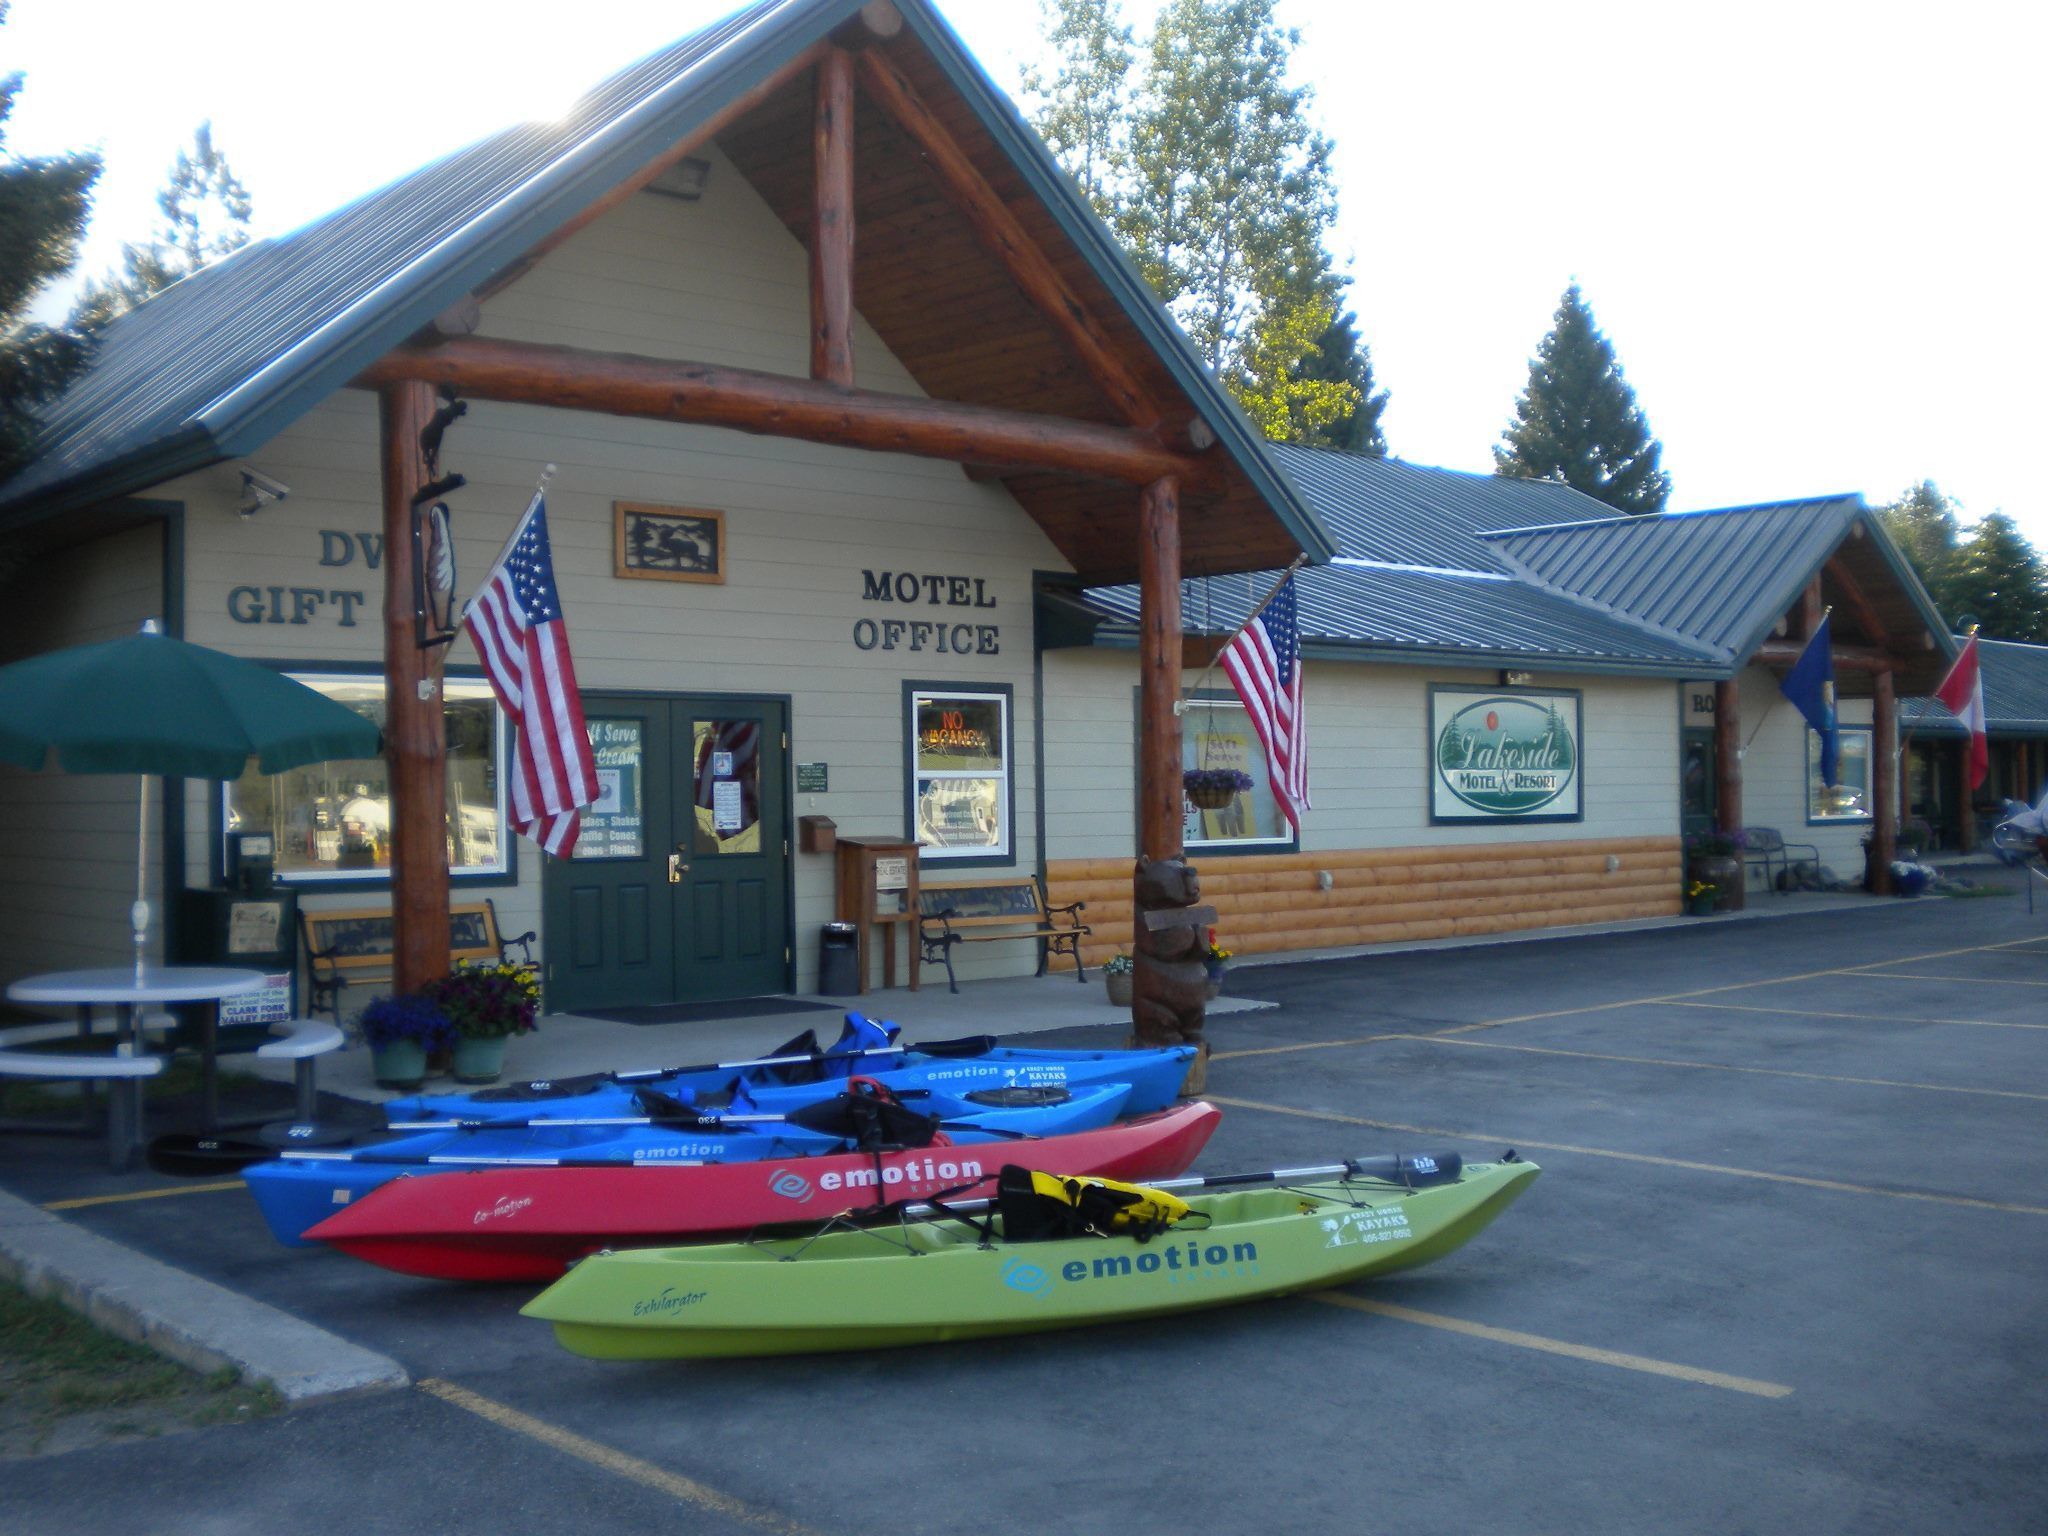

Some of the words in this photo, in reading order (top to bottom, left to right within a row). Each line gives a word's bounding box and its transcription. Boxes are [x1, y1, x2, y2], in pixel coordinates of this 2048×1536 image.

[862, 569, 996, 608] MOTEL
[228, 586, 364, 627] GIFT
[854, 618, 999, 655] OFFICE
[943, 711, 963, 729] NO
[604, 723, 638, 742] Serve
[597, 747, 639, 766] Cream
[1460, 728, 1559, 770] Lakeside
[1460, 773, 1498, 790] MOTEL
[1515, 773, 1556, 788] RESORT
[611, 816, 640, 826] Shakes
[609, 830, 636, 841] Cones
[222, 1014, 257, 1024] VALLEY
[260, 1012, 289, 1022] PRESS
[227, 1005, 258, 1015] CLARK
[261, 1003, 285, 1012] FORK
[927, 1066, 998, 1081] emotion
[633, 1143, 725, 1159] emotion
[819, 1158, 983, 1191] emotion
[1356, 1215, 1409, 1231] KAYAKS
[1062, 1241, 1258, 1282] emotion
